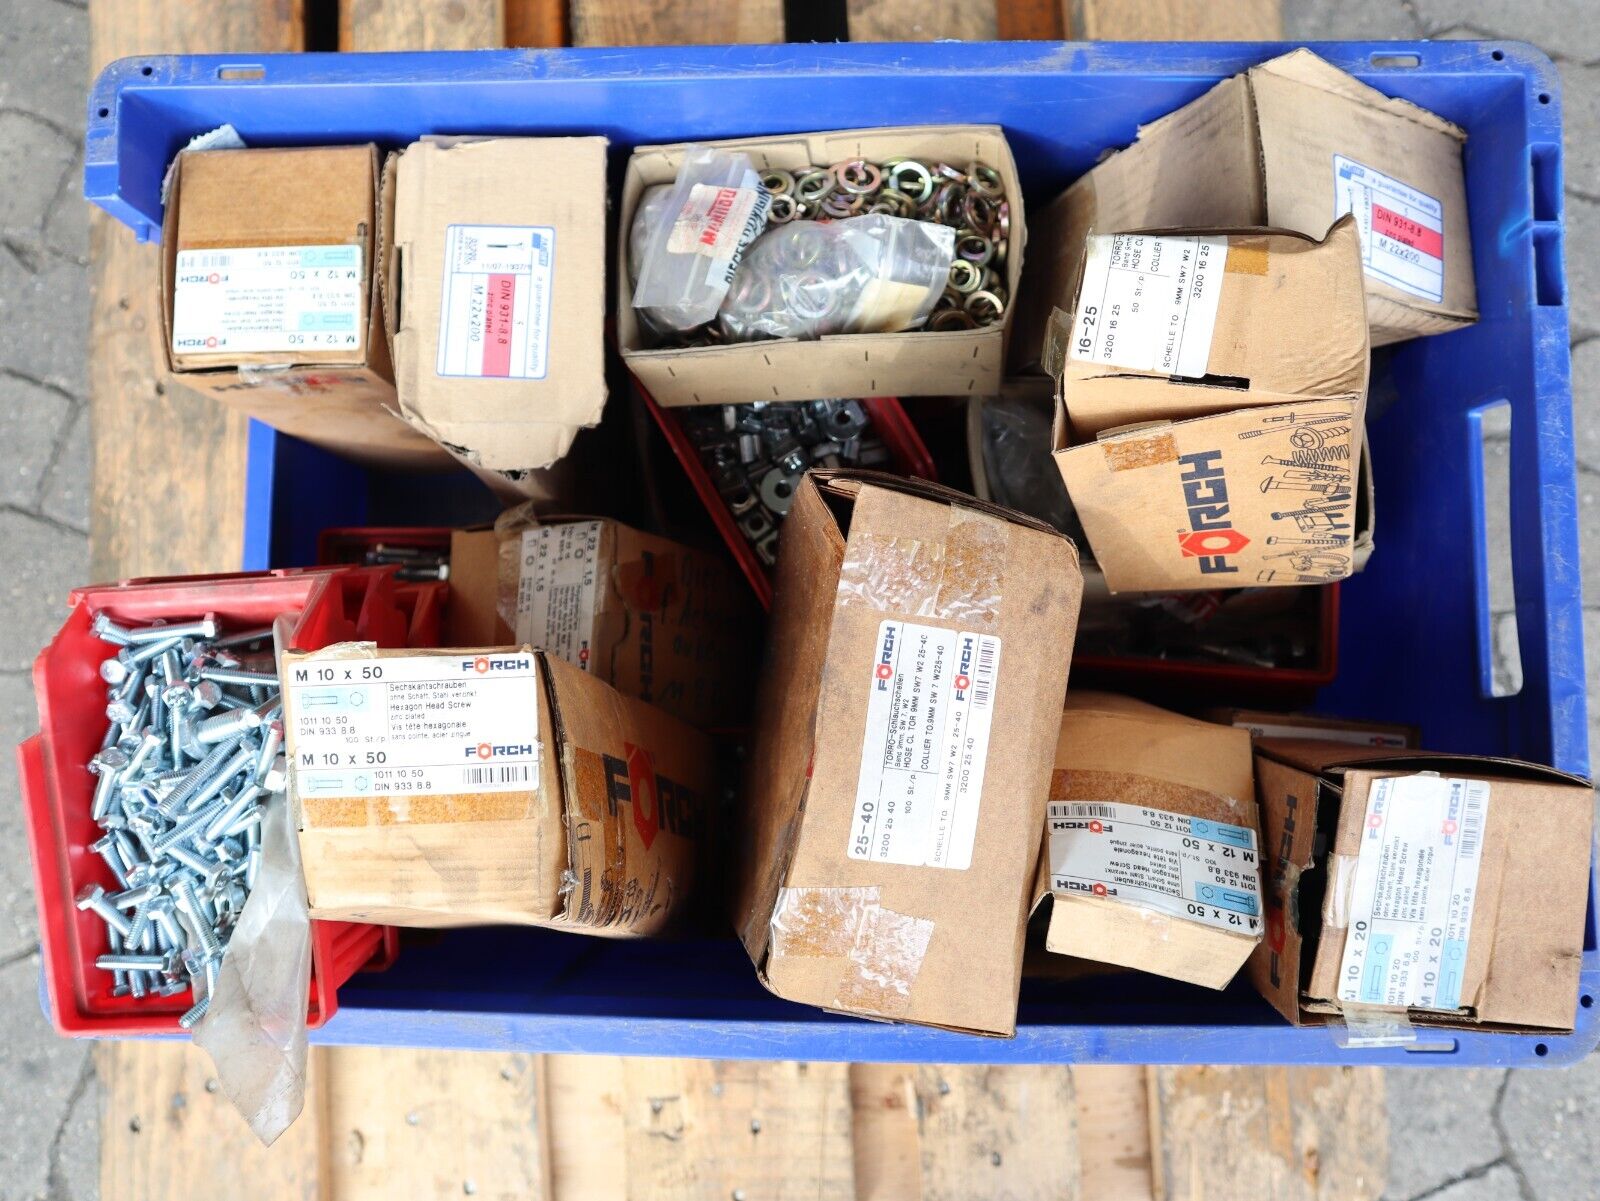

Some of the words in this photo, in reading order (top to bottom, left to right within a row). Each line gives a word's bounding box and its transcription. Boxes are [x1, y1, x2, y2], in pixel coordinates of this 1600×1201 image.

[1150, 242, 1162, 272] COLLIER
[1182, 249, 1191, 262] W2
[1200, 245, 1210, 257] 25
[1132, 249, 1142, 270] HOSE
[1198, 260, 1207, 270] 16
[289, 270, 305, 279] 50
[327, 270, 338, 279] 12
[346, 271, 355, 279] M
[1178, 265, 1188, 284] SW7
[474, 285, 483, 295] M
[501, 280, 511, 300] DIN
[1193, 274, 1205, 299] 3200
[1174, 287, 1184, 305] 9MM
[1111, 304, 1121, 316] 25
[1131, 302, 1140, 313] 50
[470, 299, 482, 342] 22x200
[497, 304, 509, 344] 931-8.8
[1109, 320, 1117, 330] 16
[1078, 306, 1097, 354] 16-25
[288, 334, 304, 344] 50
[326, 334, 338, 343] 12
[345, 335, 354, 343] M
[1103, 334, 1115, 359] 3200
[1162, 331, 1176, 368] SCHELLE
[1178, 450, 1250, 574] FÖRCH
[875, 626, 896, 692] FÖRCH
[932, 645, 945, 681] W225-40
[296, 669, 308, 681] M
[317, 668, 334, 681] 10
[344, 670, 352, 680] x
[362, 666, 383, 679] 50
[462, 657, 530, 674] FÖRCH
[915, 661, 925, 673] W2
[954, 637, 973, 702] FÖRCH
[390, 682, 467, 692] Sechskantschrauben
[912, 675, 922, 693] SW7
[901, 698, 910, 709] W2
[929, 691, 938, 704] SW
[390, 703, 423, 712] Hexagon
[425, 701, 445, 710] Head
[448, 700, 472, 709] Screw
[909, 695, 920, 713] 9MM
[300, 717, 317, 726] 1011
[322, 716, 331, 725] 10
[335, 715, 348, 725] 50
[885, 673, 905, 765] TORRO-Schlauchschellen
[907, 715, 917, 730] TOR
[952, 711, 962, 738] 25-40
[300, 728, 315, 736] DIN
[319, 727, 337, 735] 933
[423, 721, 467, 731] hexagonale
[345, 736, 359, 744] 100
[906, 734, 915, 745] CL
[966, 737, 975, 750] 40
[302, 754, 314, 766] M
[322, 753, 339, 765] 10
[348, 755, 357, 764] x
[366, 751, 387, 764] 50
[465, 742, 533, 760] FÖRCH
[920, 738, 932, 770] COLLIER
[949, 744, 958, 758] W2
[903, 747, 913, 768] HOSE
[964, 754, 973, 766] 25
[374, 770, 392, 779] 1011
[397, 769, 407, 778] 10
[411, 769, 424, 778] 50
[946, 761, 956, 780] SW7
[374, 783, 390, 791] DIN
[394, 782, 413, 791] 933
[959, 769, 971, 794] 3200
[943, 783, 952, 801] 9MM
[886, 801, 896, 814] 40
[904, 800, 913, 814] 100
[1142, 810, 1155, 818] 8.8
[1158, 813, 1174, 821] 933
[884, 818, 894, 830] 25
[1150, 820, 1161, 828] 50
[1164, 822, 1172, 830] 12
[1177, 817, 1191, 825] DIN
[854, 801, 875, 855] 25-40
[1053, 821, 1113, 834] FÖRCH
[1175, 825, 1191, 834] 1011
[879, 833, 891, 858] 3200
[933, 826, 946, 862] SCHELLE
[1182, 838, 1200, 850] 50
[1207, 843, 1215, 851] x
[1113, 847, 1151, 858] hexagonale
[1153, 854, 1166, 863] tête
[1222, 847, 1236, 858] 12
[1243, 851, 1254, 863] M
[1399, 842, 1409, 865] Screw
[1109, 860, 1131, 869] Screw
[1168, 857, 1178, 866] Vis
[1204, 858, 1217, 866] 100
[1133, 864, 1150, 873] Head
[1152, 868, 1180, 880] Hexagon
[1207, 866, 1221, 875] 8.8
[1224, 869, 1239, 879] 933
[1413, 849, 1425, 889] hexagonale
[1215, 875, 1226, 884] 50
[1242, 874, 1256, 883] DIN
[1372, 844, 1391, 917] Sechskantschrauben
[1396, 867, 1406, 885] Head
[1056, 879, 1118, 897] FÖRCH
[1114, 876, 1180, 897] Sechskantschrauben
[1229, 878, 1237, 887] 12
[1240, 881, 1256, 891] 1011
[1391, 887, 1402, 918] Hexagon
[1451, 894, 1461, 906] 20
[1187, 903, 1205, 917] 50
[1212, 909, 1220, 919] x
[1409, 908, 1418, 919] Vis
[1450, 909, 1459, 919] 10
[1227, 913, 1242, 926] 12
[1249, 918, 1258, 929] M
[1354, 920, 1368, 941] 20
[1447, 923, 1457, 941] 1011
[1428, 927, 1442, 947] 20
[1353, 949, 1362, 957] x
[1392, 958, 1401, 970] 20
[1428, 955, 1439, 964] x
[1347, 965, 1360, 981] 10
[1389, 974, 1398, 984] 10
[1398, 970, 1408, 988] 933
[1422, 972, 1436, 988] 10
[1387, 987, 1396, 1004] 1011
[1420, 995, 1432, 1008] M
